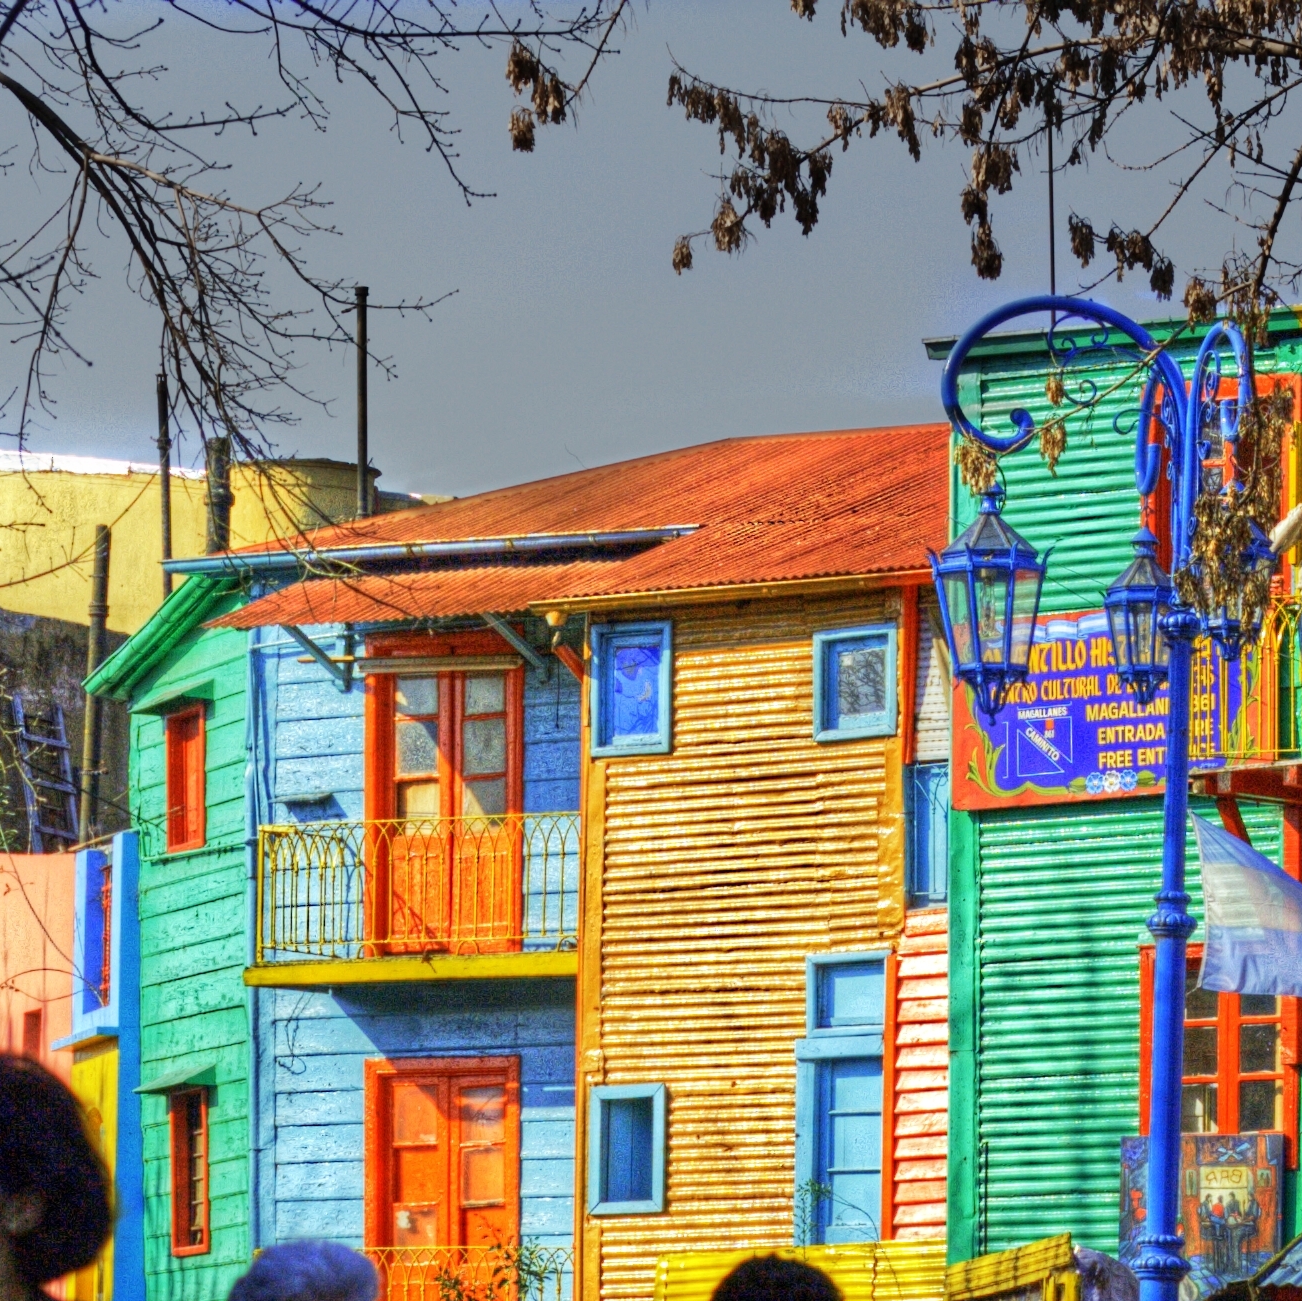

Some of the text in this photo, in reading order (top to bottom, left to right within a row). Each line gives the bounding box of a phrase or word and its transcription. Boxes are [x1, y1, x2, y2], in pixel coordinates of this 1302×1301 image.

[981, 638, 1087, 675] ONENTILLO
[1041, 675, 1102, 700] CULTURAL
[1017, 706, 1068, 720] MAGALLANES
[1085, 697, 1170, 722] MAGALLAN
[1025, 726, 1060, 761] CAMINITO
[1098, 722, 1165, 745] ENTRADA
[1099, 750, 1133, 770] FREE
